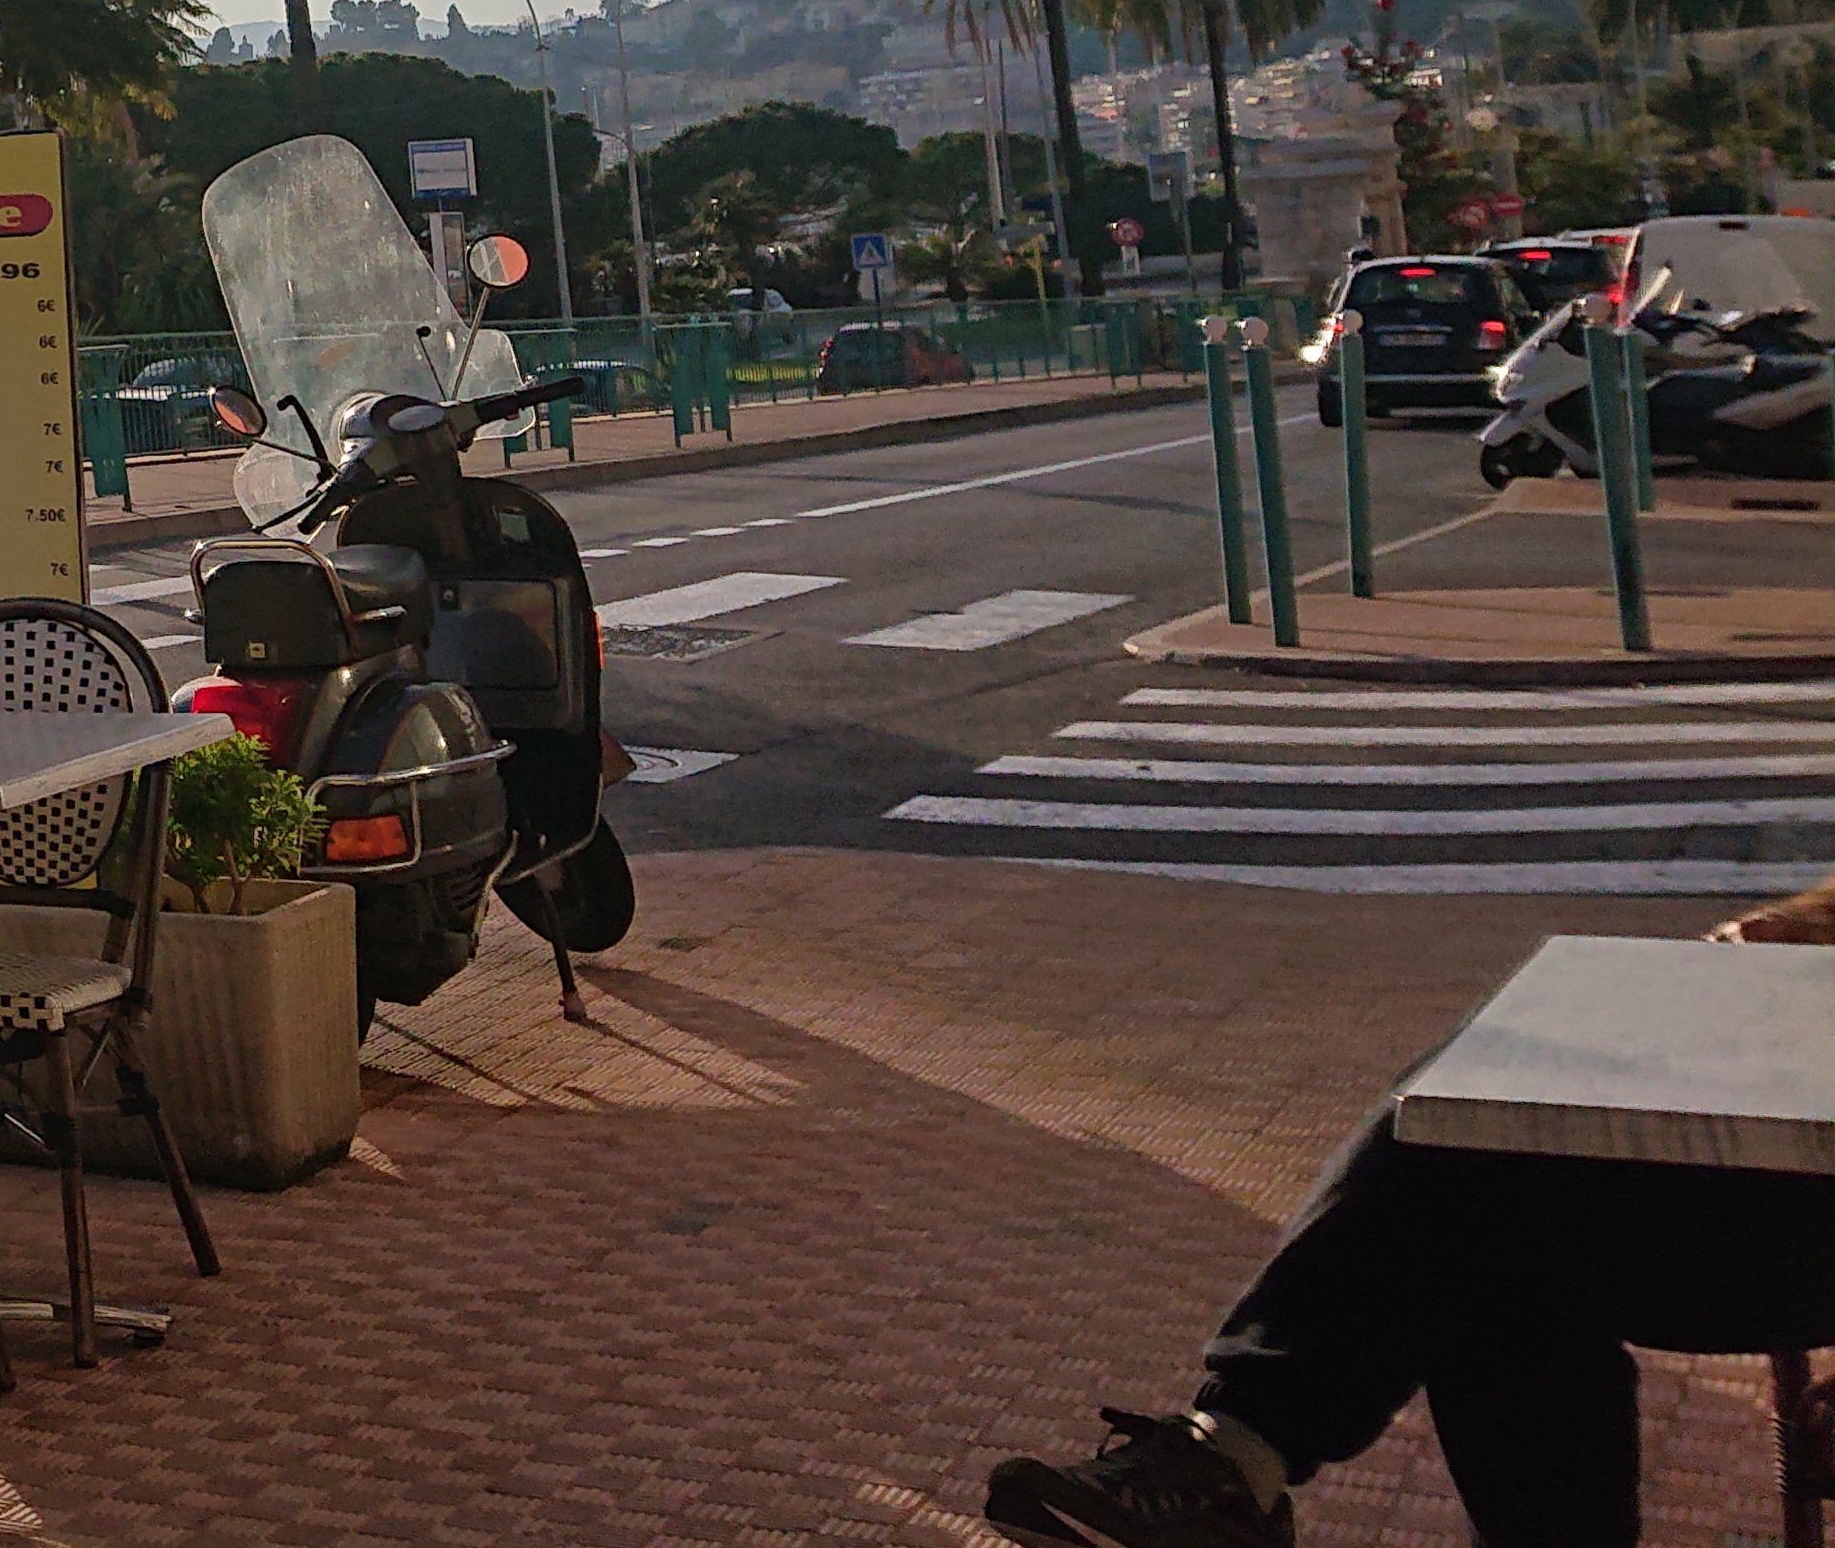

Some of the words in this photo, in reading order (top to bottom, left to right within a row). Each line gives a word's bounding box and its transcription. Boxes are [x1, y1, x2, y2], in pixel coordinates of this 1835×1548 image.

[37, 299, 55, 312] 6€
[43, 423, 61, 436] 7€
[45, 460, 63, 473] 7€
[50, 562, 68, 576] 7€
